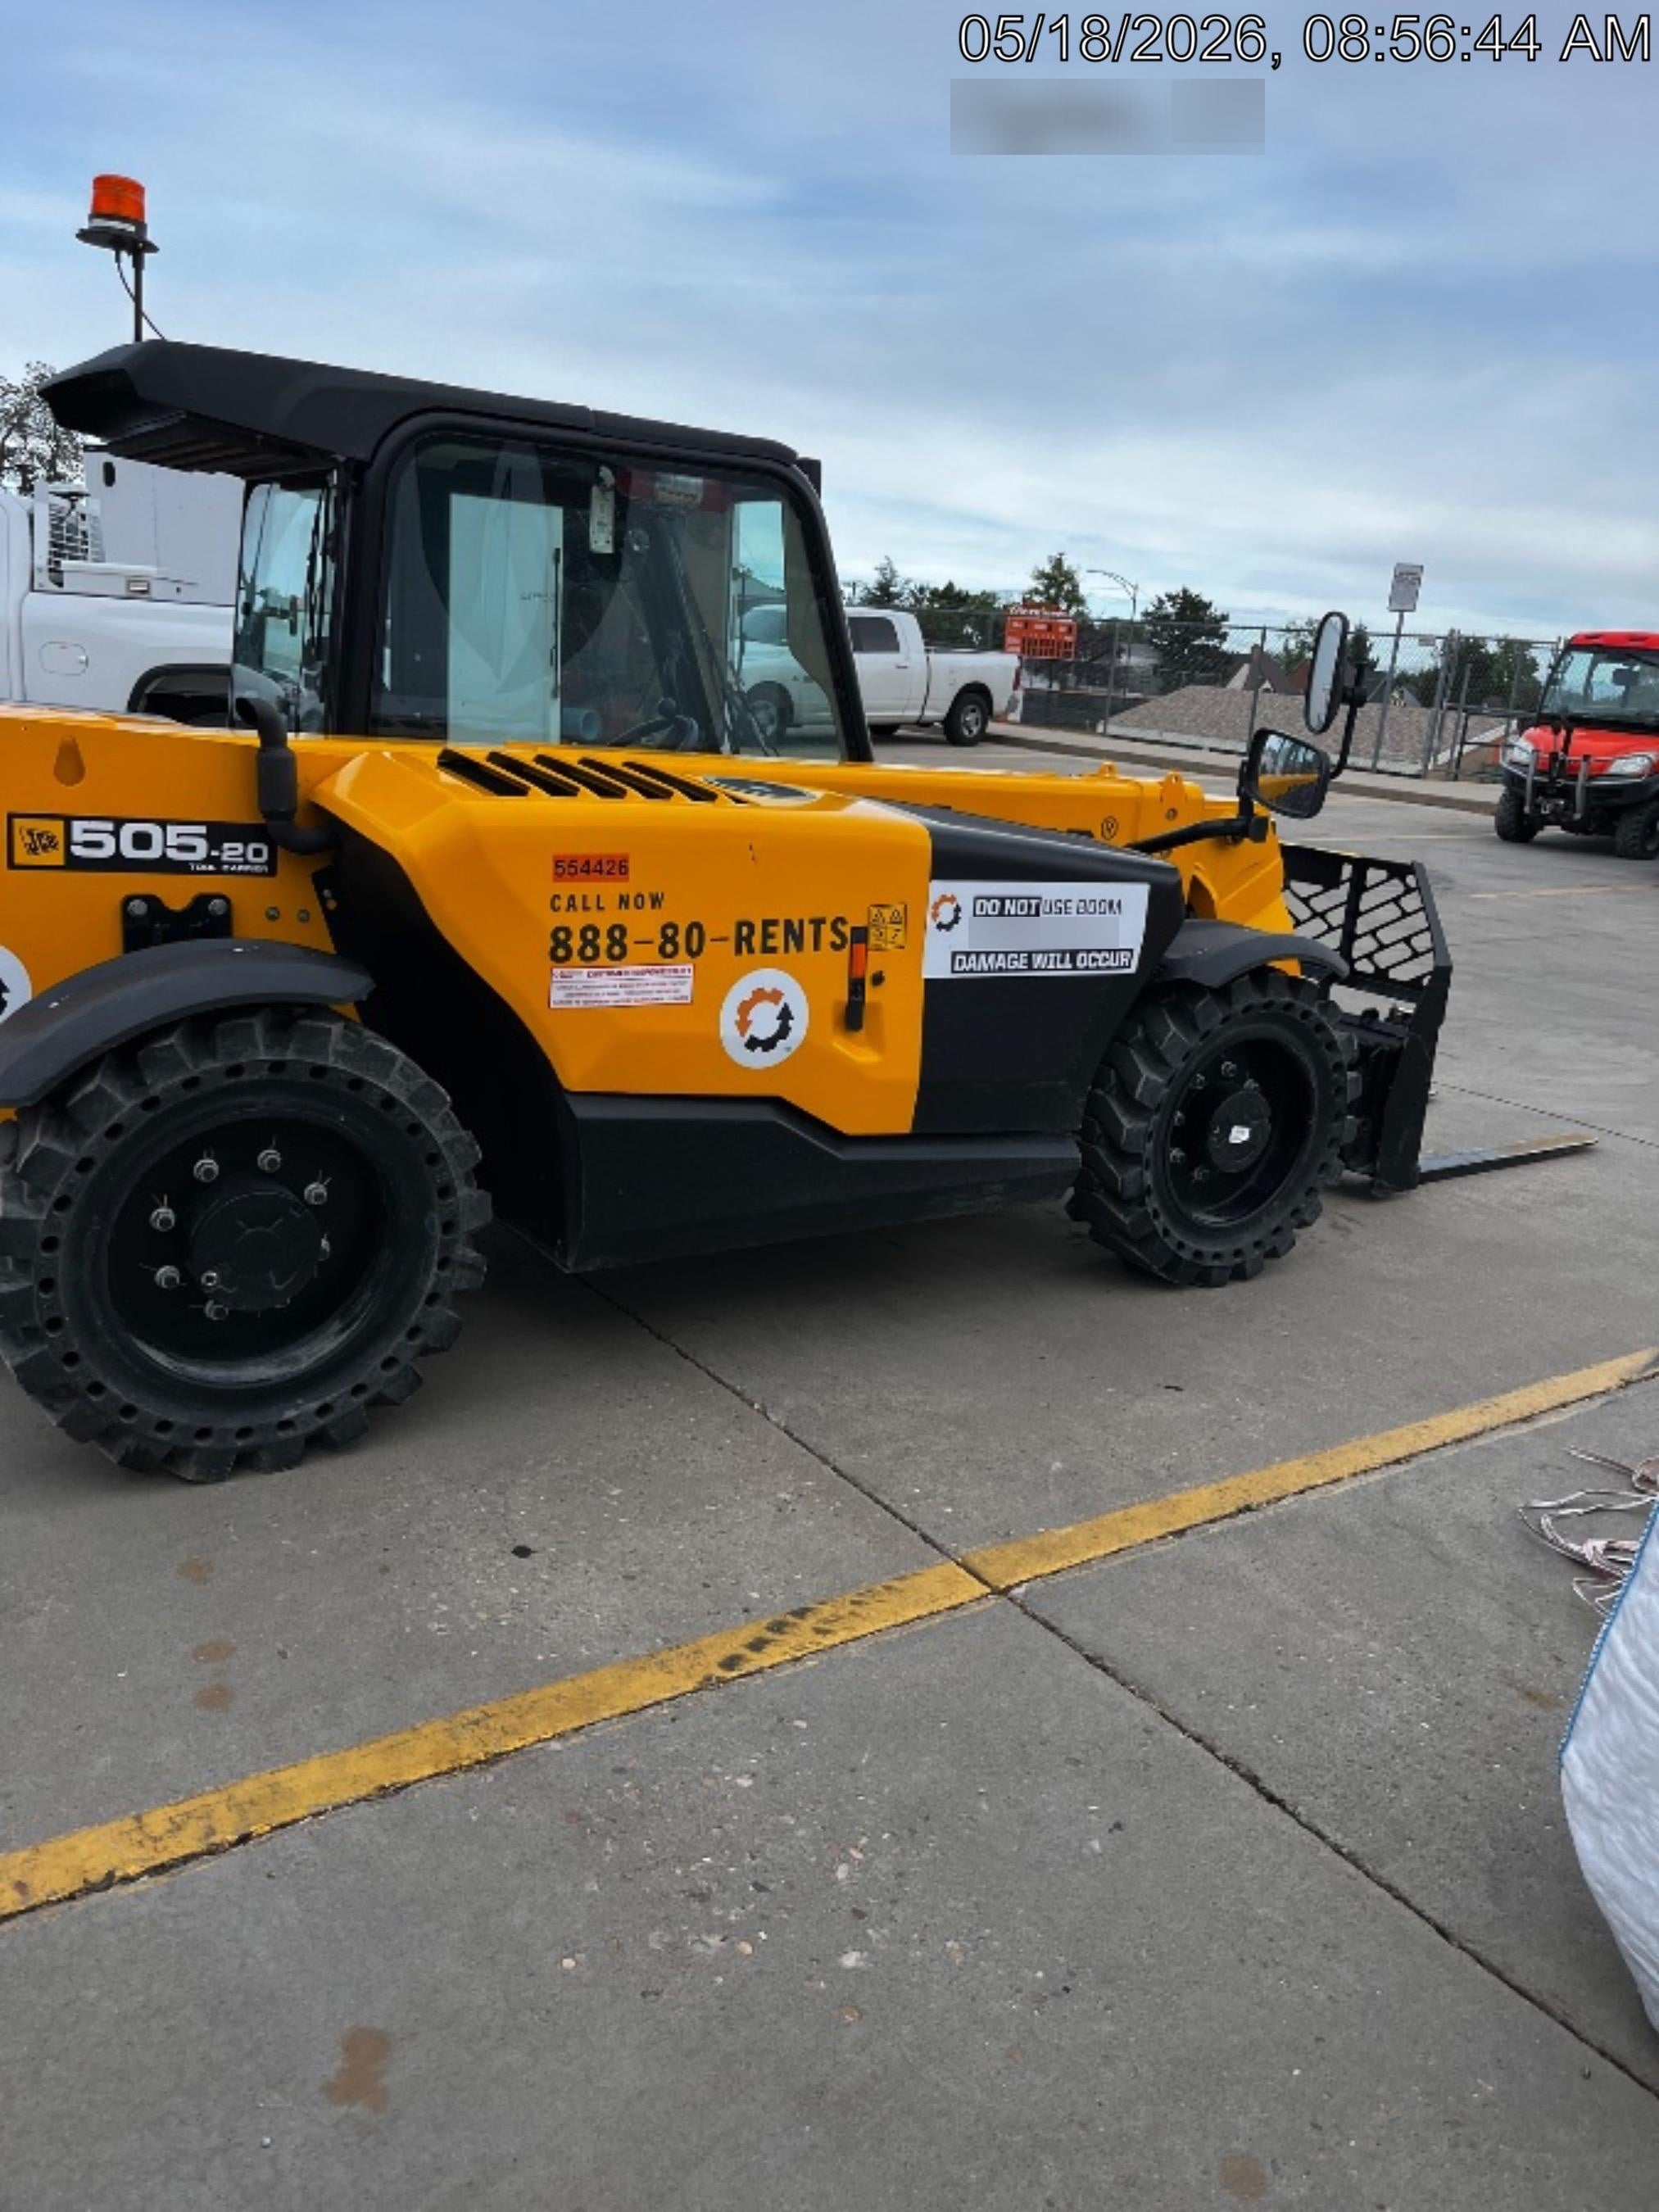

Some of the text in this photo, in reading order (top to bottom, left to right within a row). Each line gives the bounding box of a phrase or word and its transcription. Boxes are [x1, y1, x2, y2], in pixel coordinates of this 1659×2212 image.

[70, 820, 269, 863] 505-20
[555, 859, 629, 877] 554426
[551, 892, 664, 912] CALL NOW
[975, 899, 1122, 916] DO NOT USE BOOM
[549, 917, 849, 963] 888-80-RENTS
[954, 951, 1131, 972] DAMAGE WILL OCCUR
